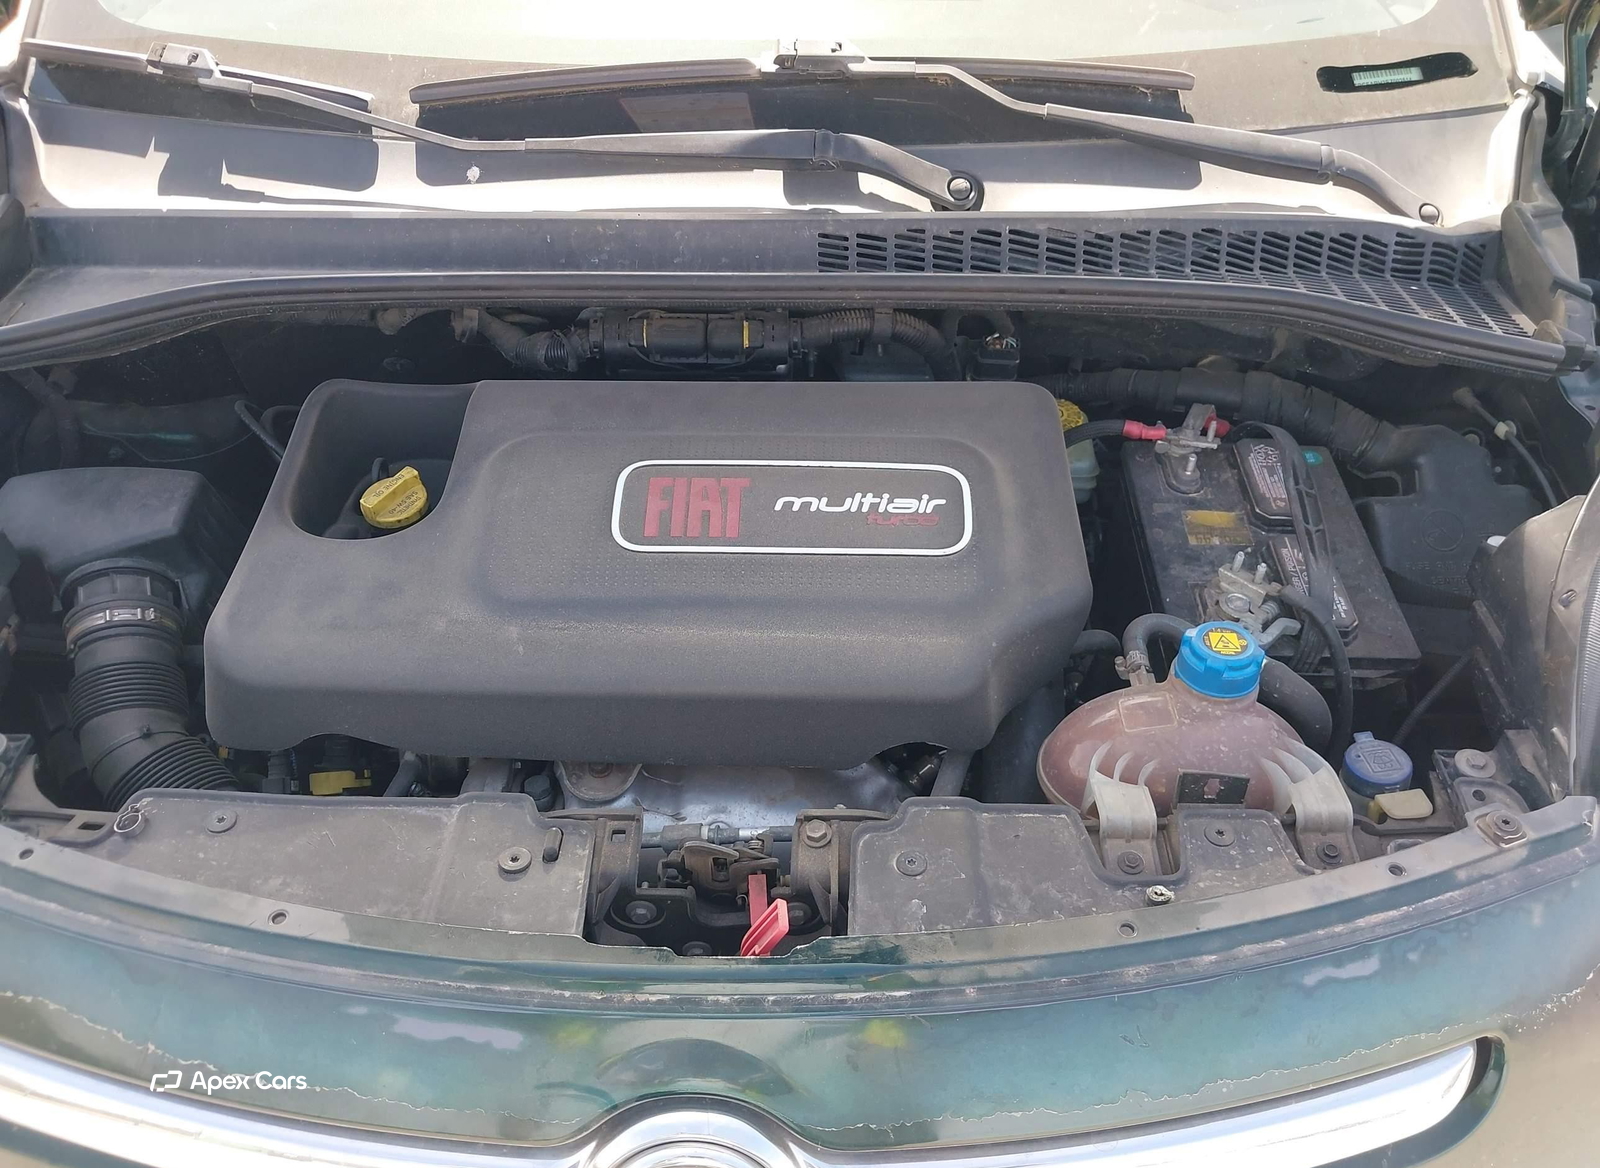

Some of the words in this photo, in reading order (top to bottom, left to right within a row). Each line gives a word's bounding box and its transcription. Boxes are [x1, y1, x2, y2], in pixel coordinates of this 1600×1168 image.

[383, 473, 405, 489] ENGINE
[373, 489, 385, 498] OIL
[643, 477, 750, 538] FIAT
[774, 492, 947, 514] multiair
[866, 512, 940, 528] turbo
